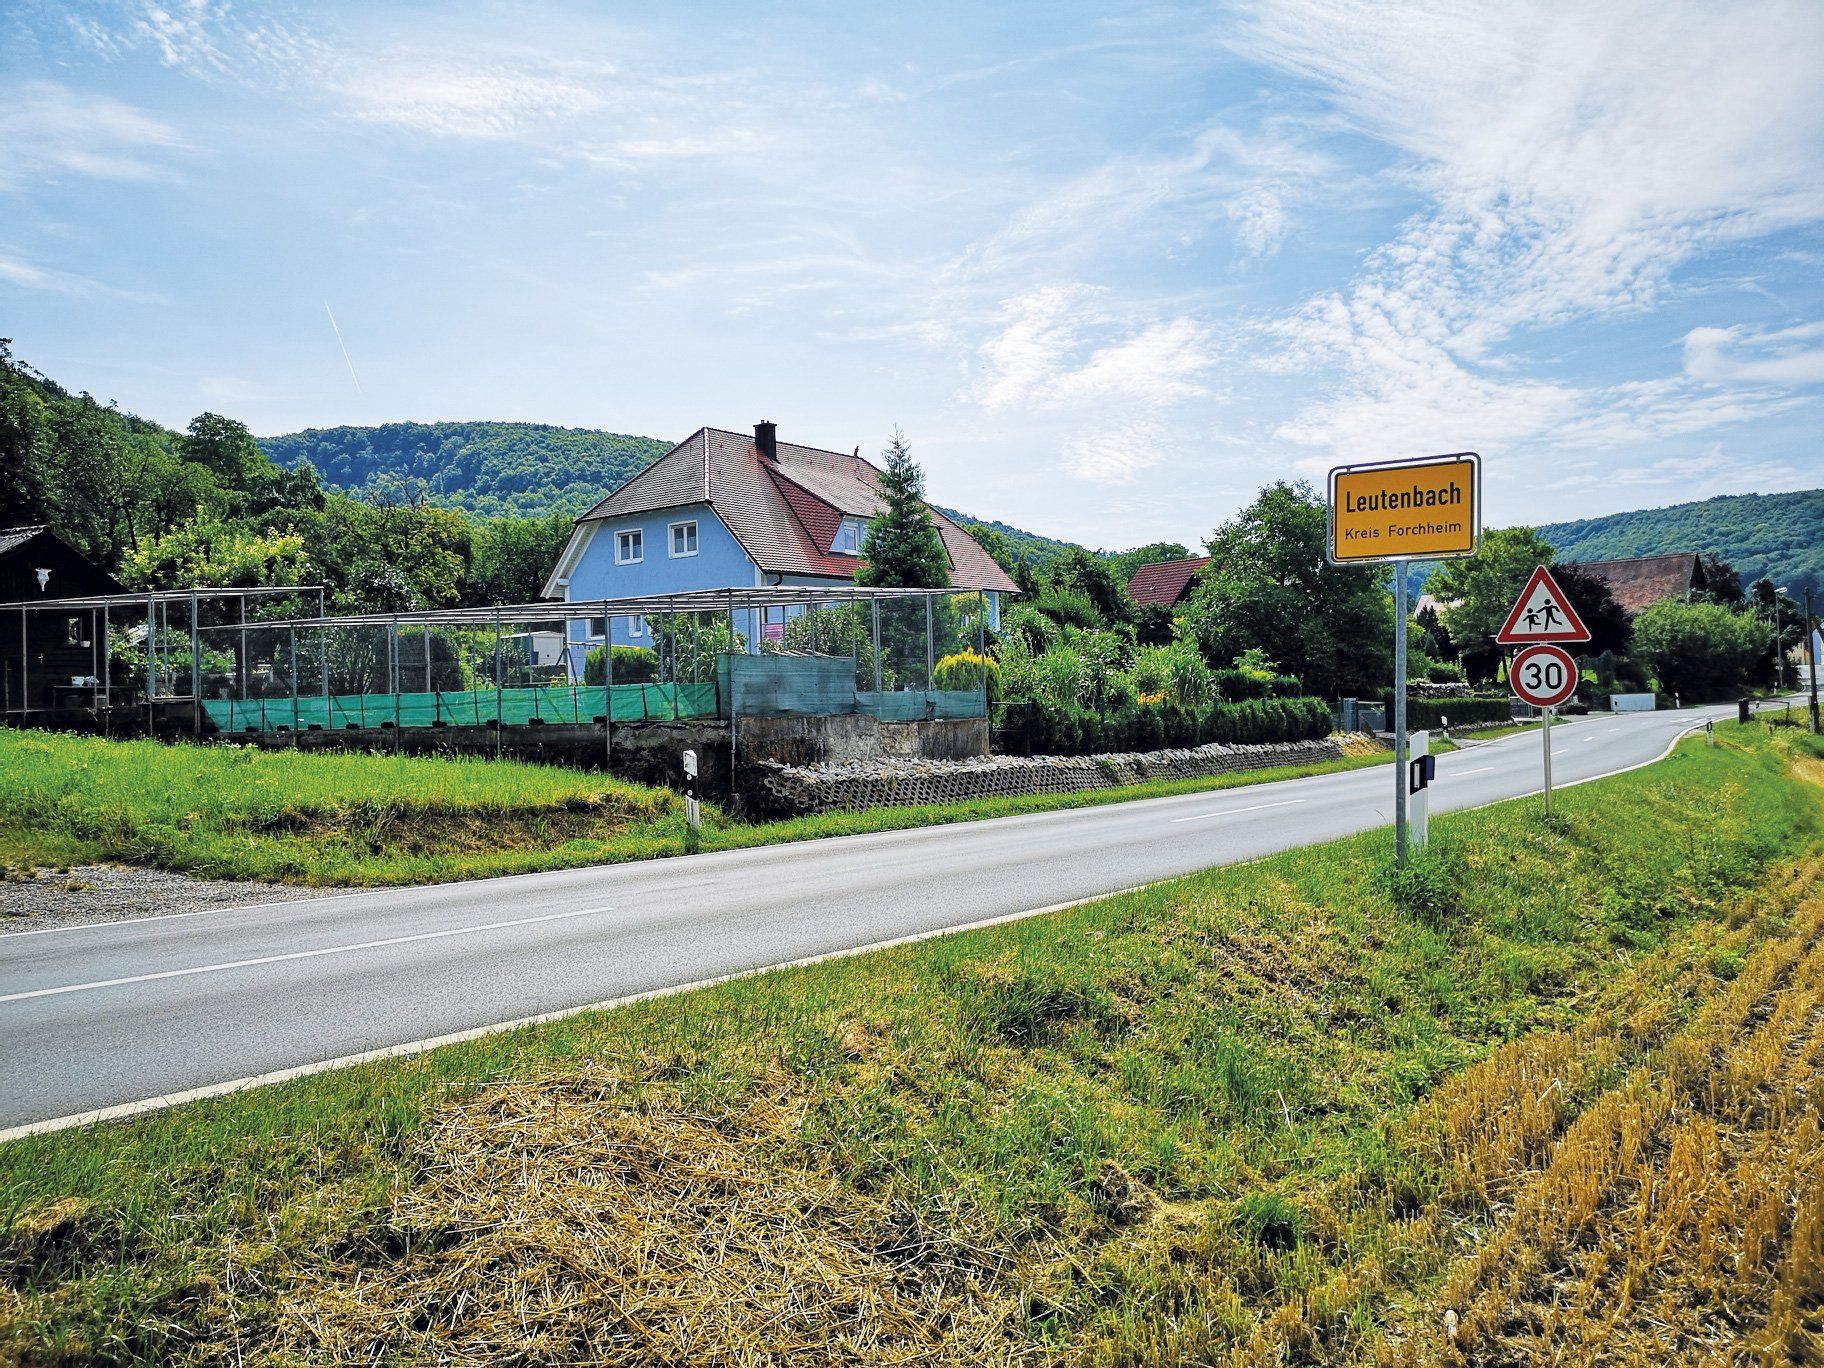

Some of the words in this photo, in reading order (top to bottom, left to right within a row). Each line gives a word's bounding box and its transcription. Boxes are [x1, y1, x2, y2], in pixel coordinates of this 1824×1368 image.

[1347, 482, 1460, 512] Leutenbach
[1345, 527, 1379, 539] Kreis
[1388, 521, 1461, 537] Forchheim
[1525, 663, 1562, 689] 30
